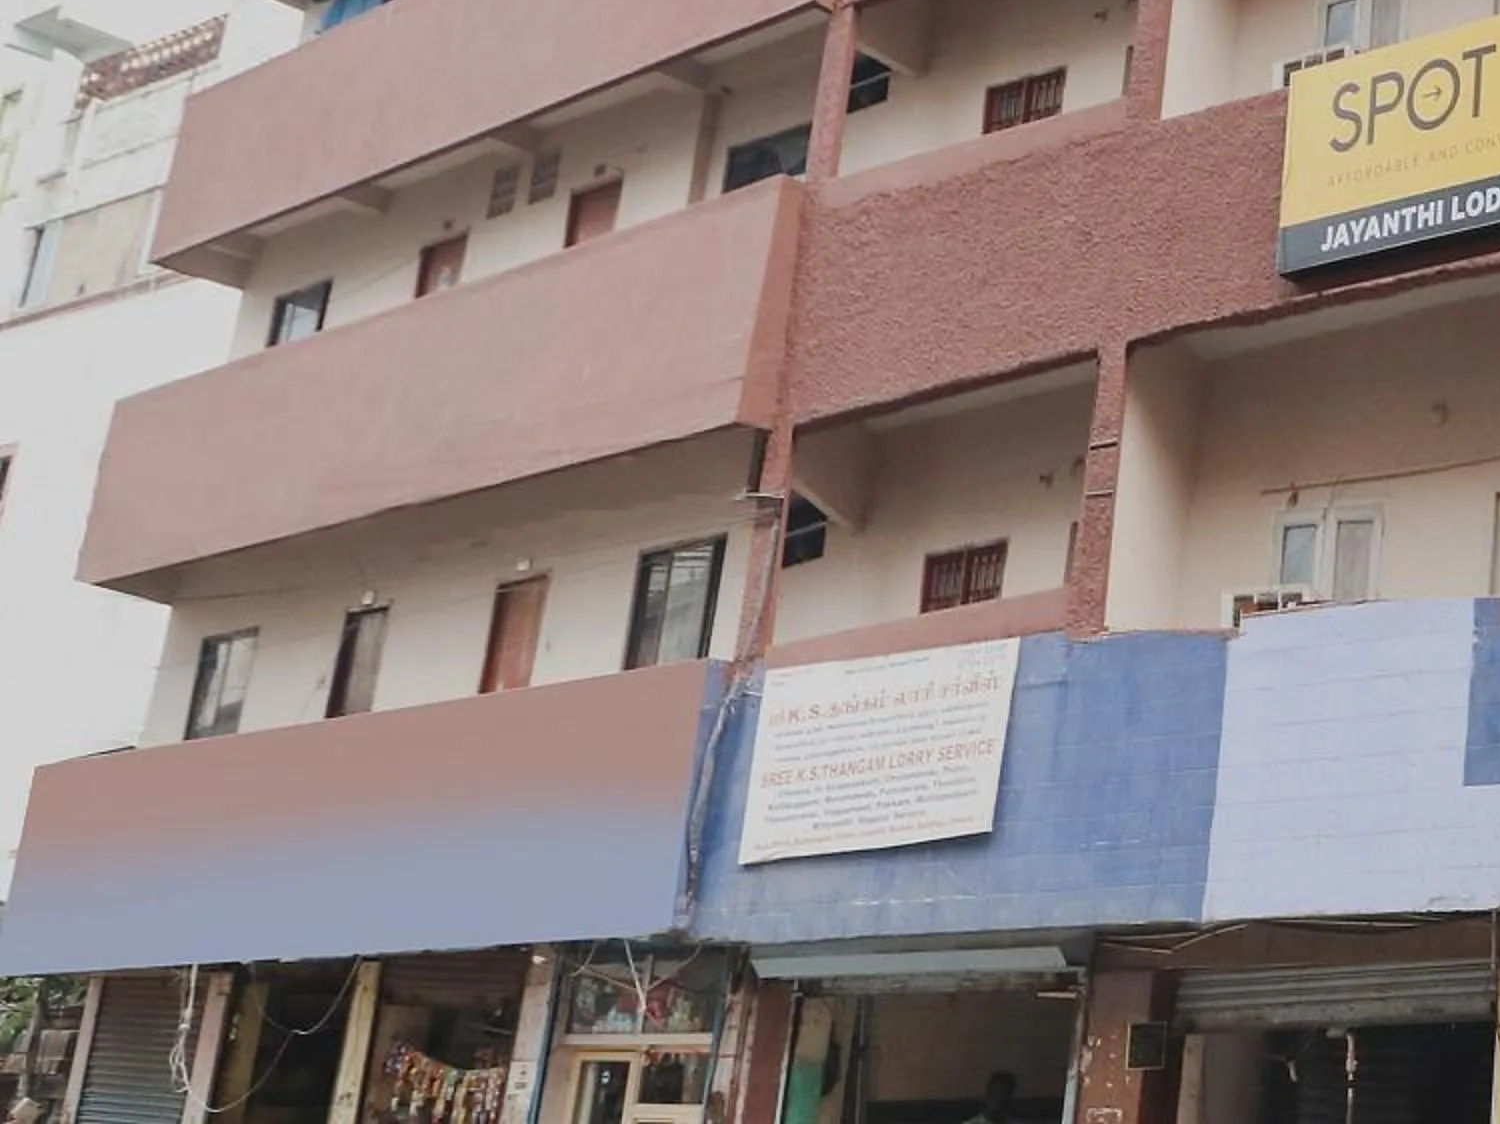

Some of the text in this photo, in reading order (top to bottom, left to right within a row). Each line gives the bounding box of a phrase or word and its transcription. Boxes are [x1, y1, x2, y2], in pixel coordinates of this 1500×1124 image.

[1329, 44, 1496, 153] SPOT
[1427, 144, 1459, 164] AND
[1321, 199, 1443, 253] JAYANTHI
[937, 738, 994, 762] SERVICE
